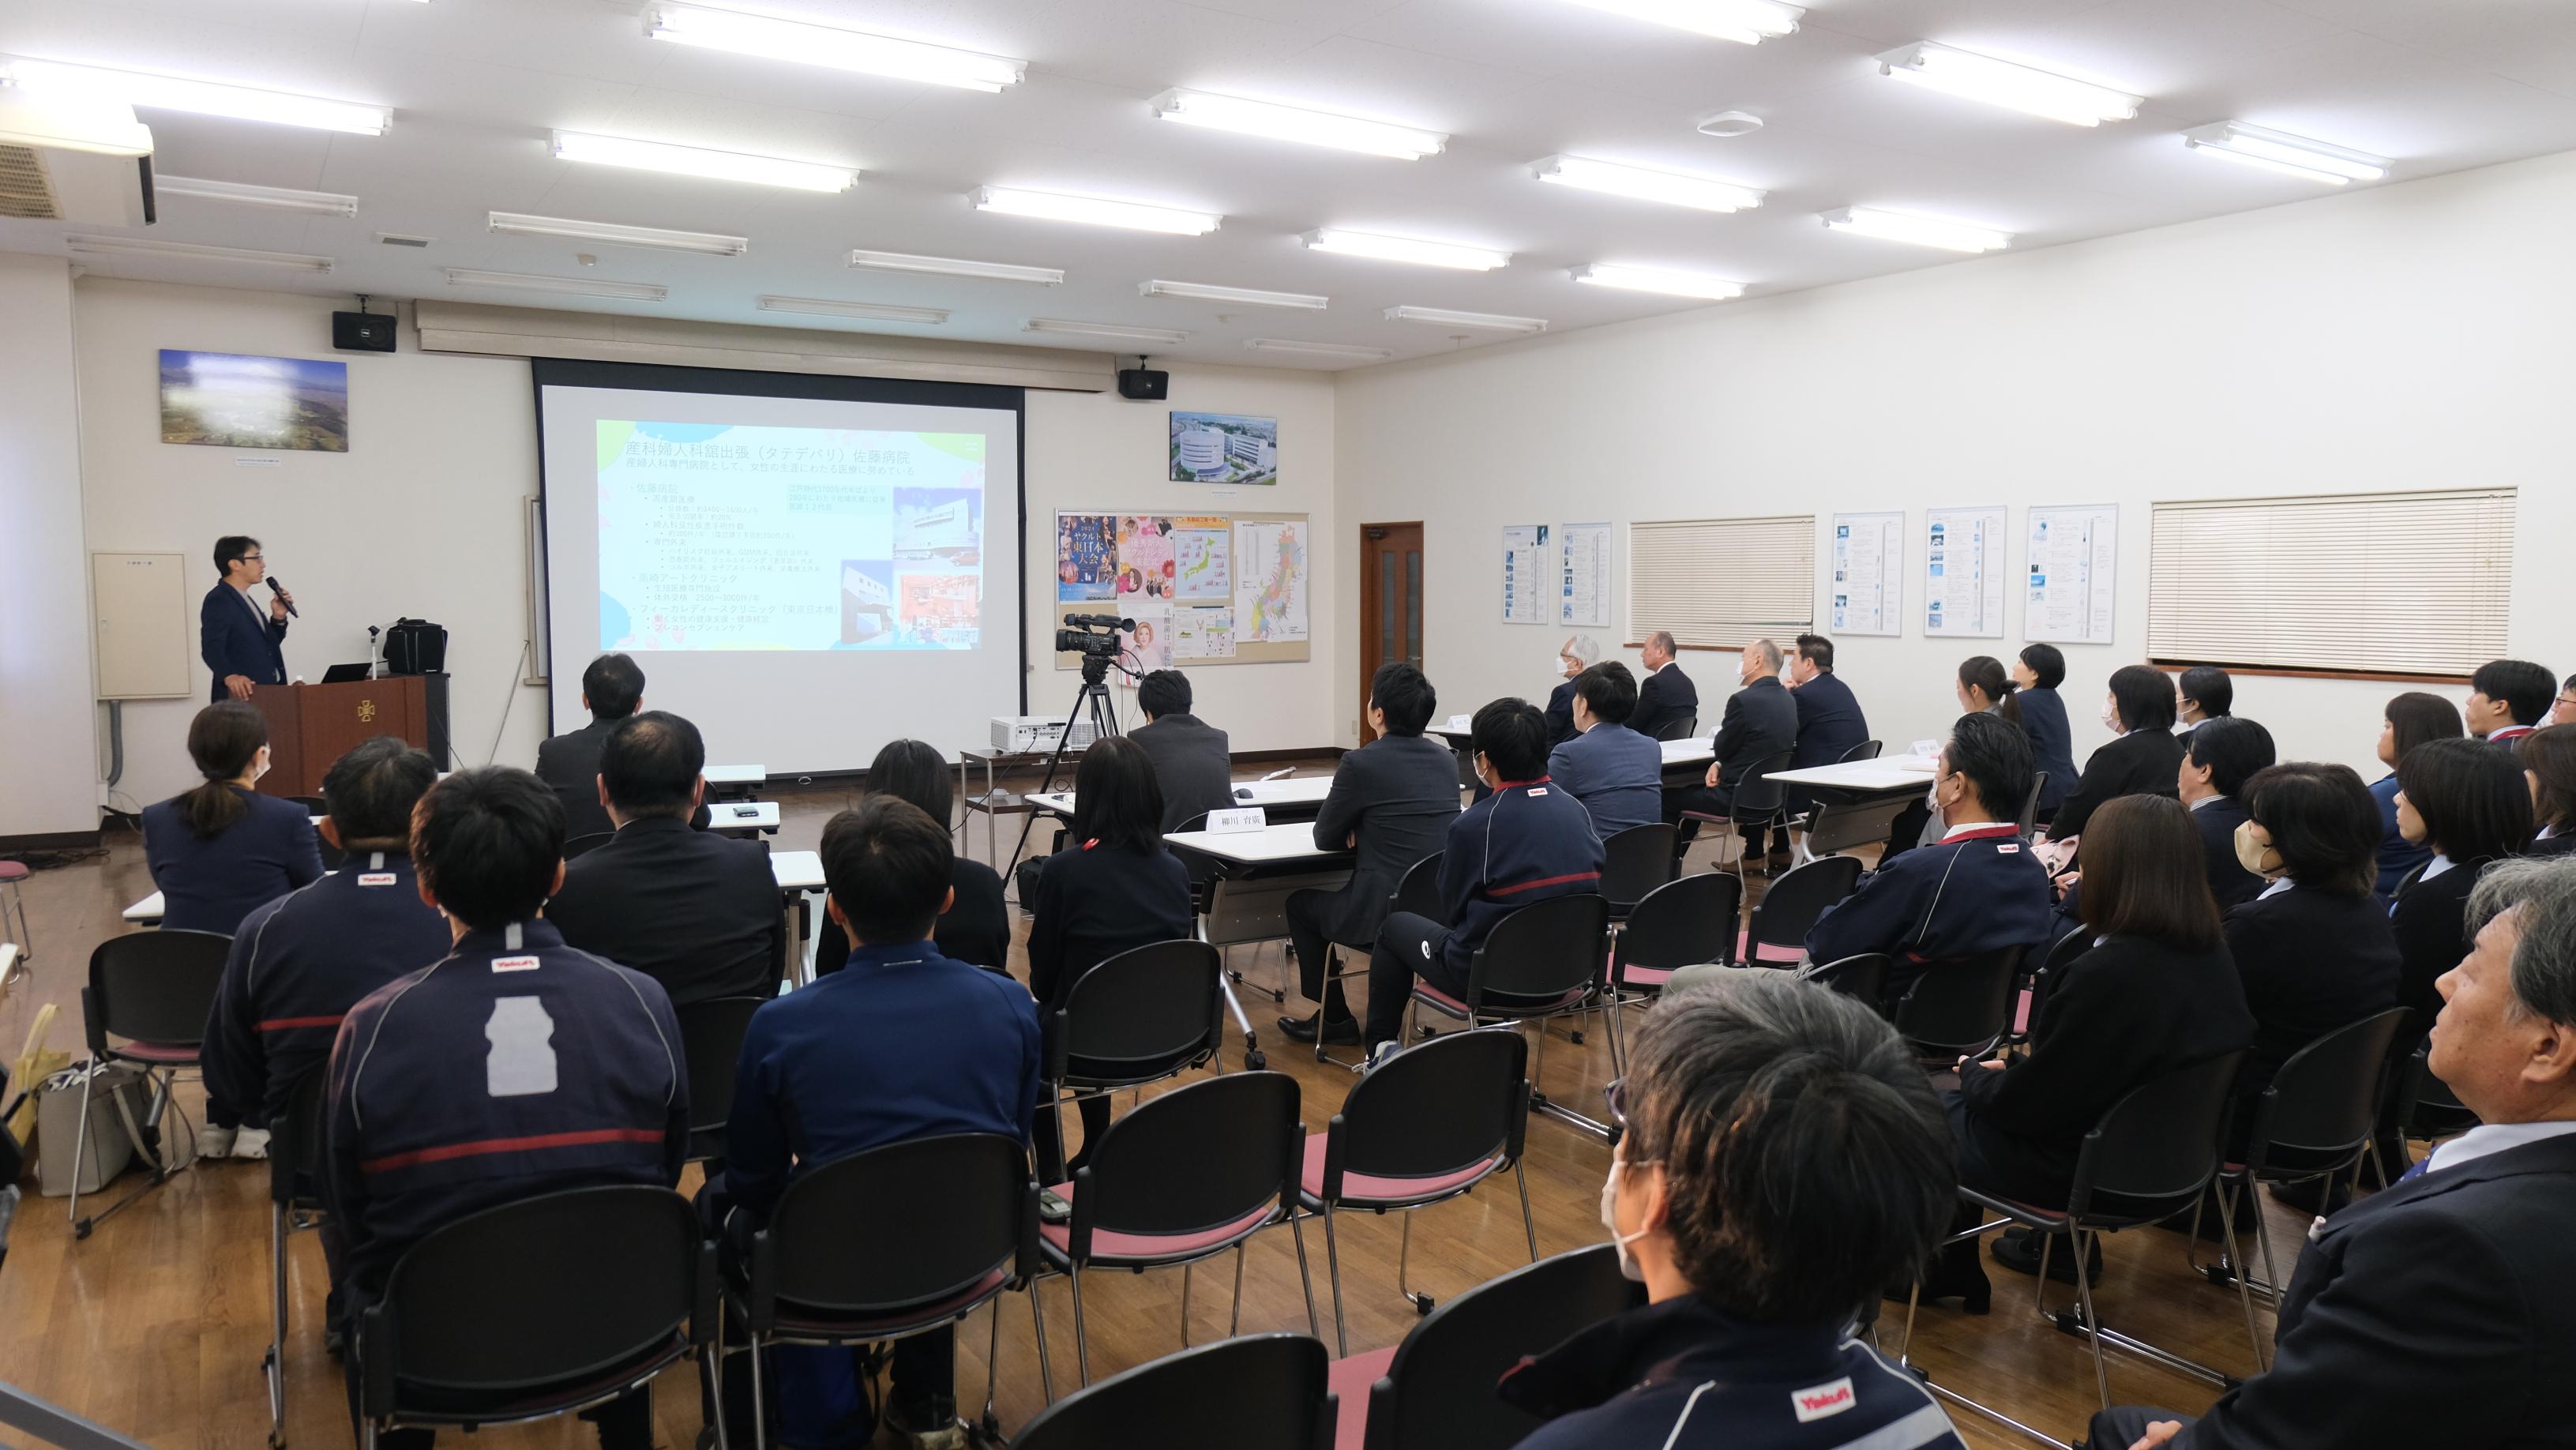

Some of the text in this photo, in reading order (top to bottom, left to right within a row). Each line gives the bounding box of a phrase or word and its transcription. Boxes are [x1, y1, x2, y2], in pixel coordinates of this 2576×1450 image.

[637, 483, 679, 494] 佐藤病院
[1074, 543, 1104, 552] 東日本
[1079, 554, 1098, 564] 大会
[1801, 1388, 1850, 1411] Yakult
